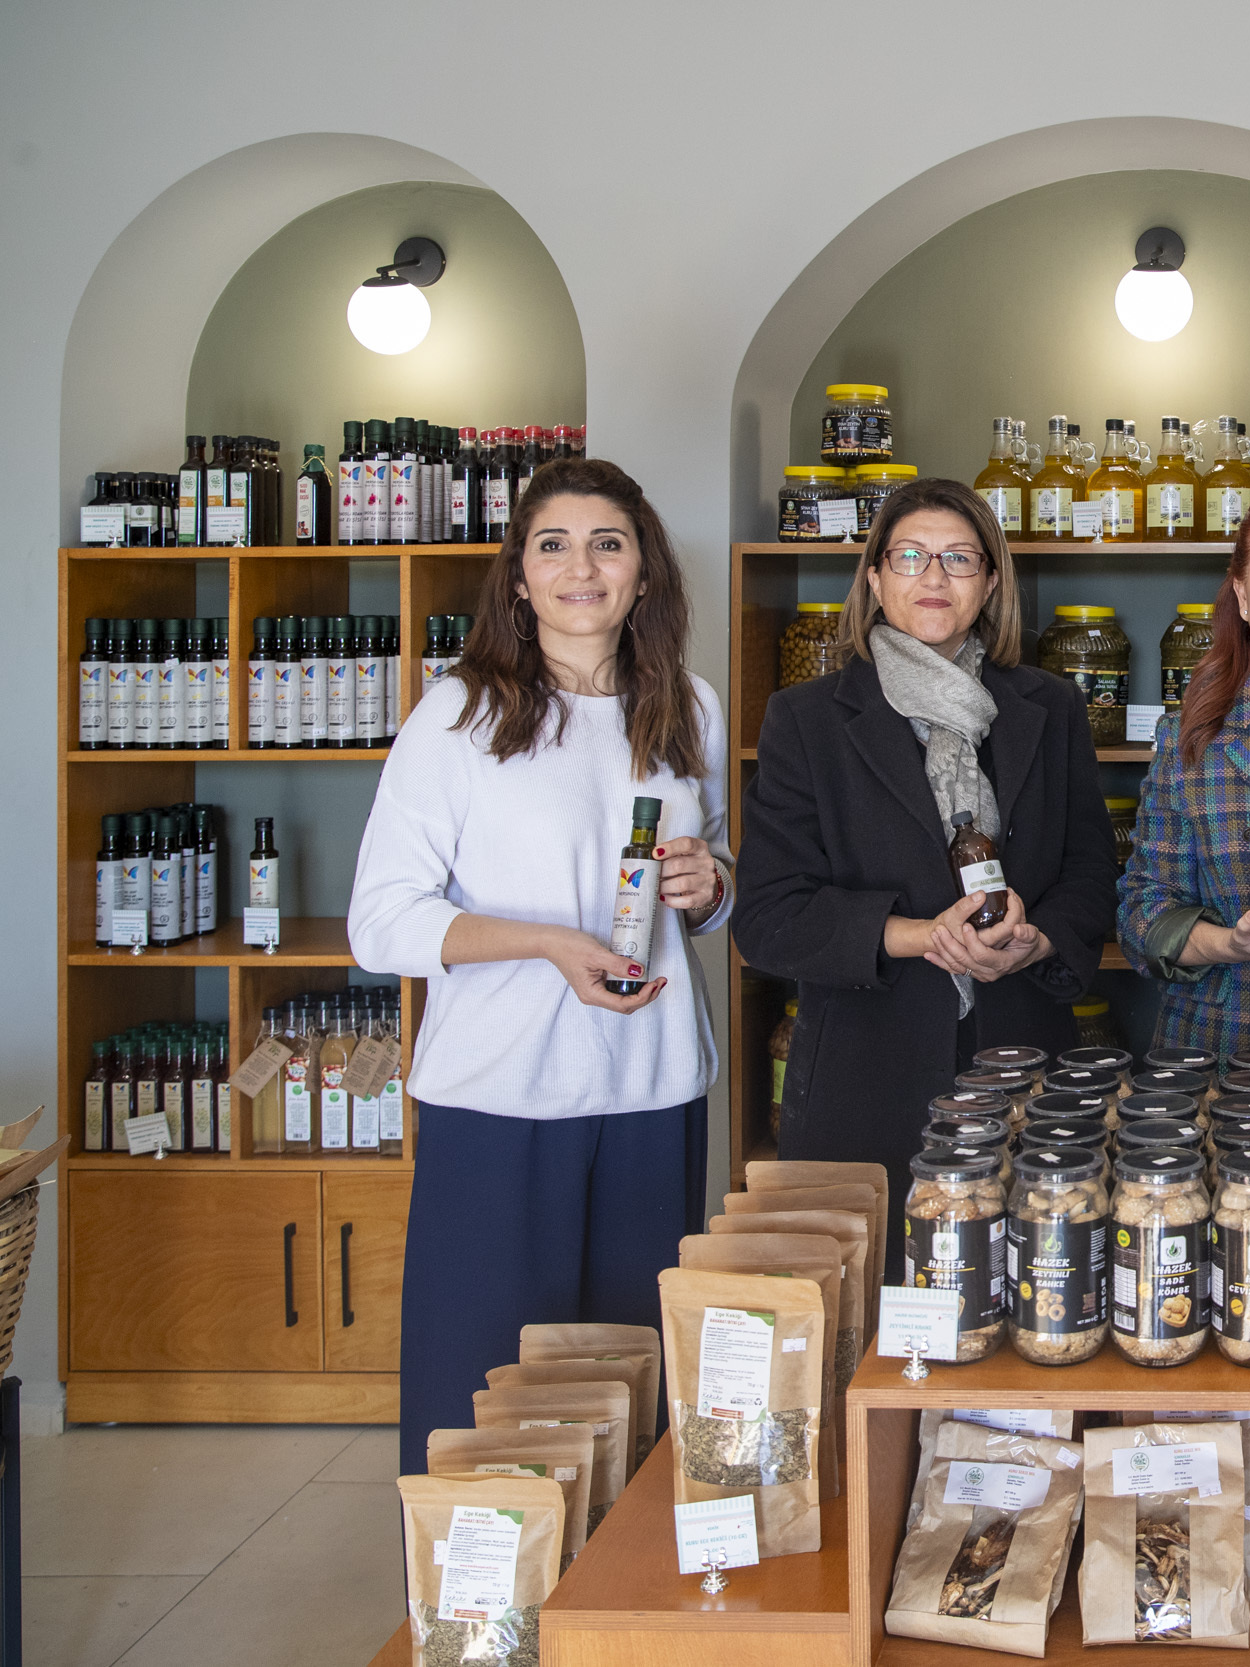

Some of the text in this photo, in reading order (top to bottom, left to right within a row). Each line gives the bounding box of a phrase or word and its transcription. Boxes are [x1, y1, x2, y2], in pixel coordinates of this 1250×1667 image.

[928, 1260, 965, 1269] HAZEK
[1032, 1257, 1070, 1267] HAZEK
[1156, 1263, 1191, 1274] HAZEK
[931, 1272, 957, 1281] SADE
[1159, 1277, 1184, 1285] SADE
[1036, 1280, 1065, 1288] KAHKE
[1158, 1286, 1190, 1296] KÖMBE
